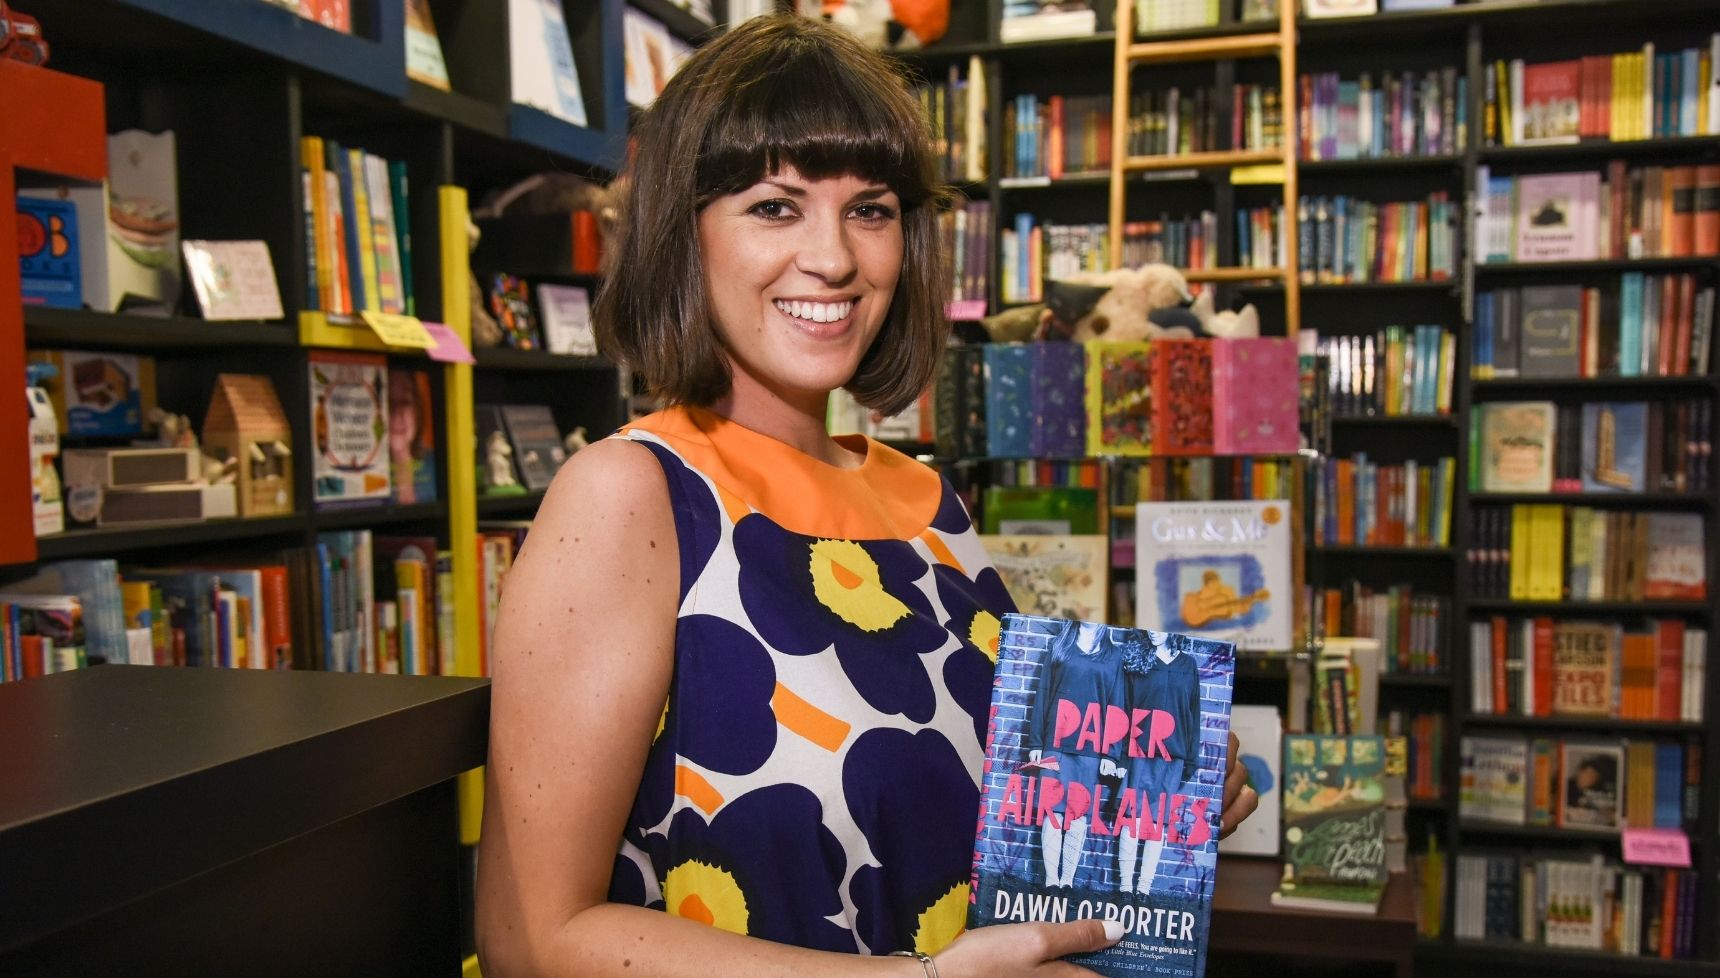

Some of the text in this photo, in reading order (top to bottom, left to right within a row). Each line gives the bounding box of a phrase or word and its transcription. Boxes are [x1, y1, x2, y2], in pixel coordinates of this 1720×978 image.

[1152, 517, 1268, 543] Gus & Me
[1053, 698, 1176, 762] PAPER
[997, 773, 1211, 846] AIRPLANES
[994, 890, 1196, 942] DAWN O'PORTER
[1140, 951, 1165, 961] Envelopes
[1141, 943, 1150, 951] You
[1159, 946, 1173, 955] going
[1154, 966, 1171, 974] BOOK
